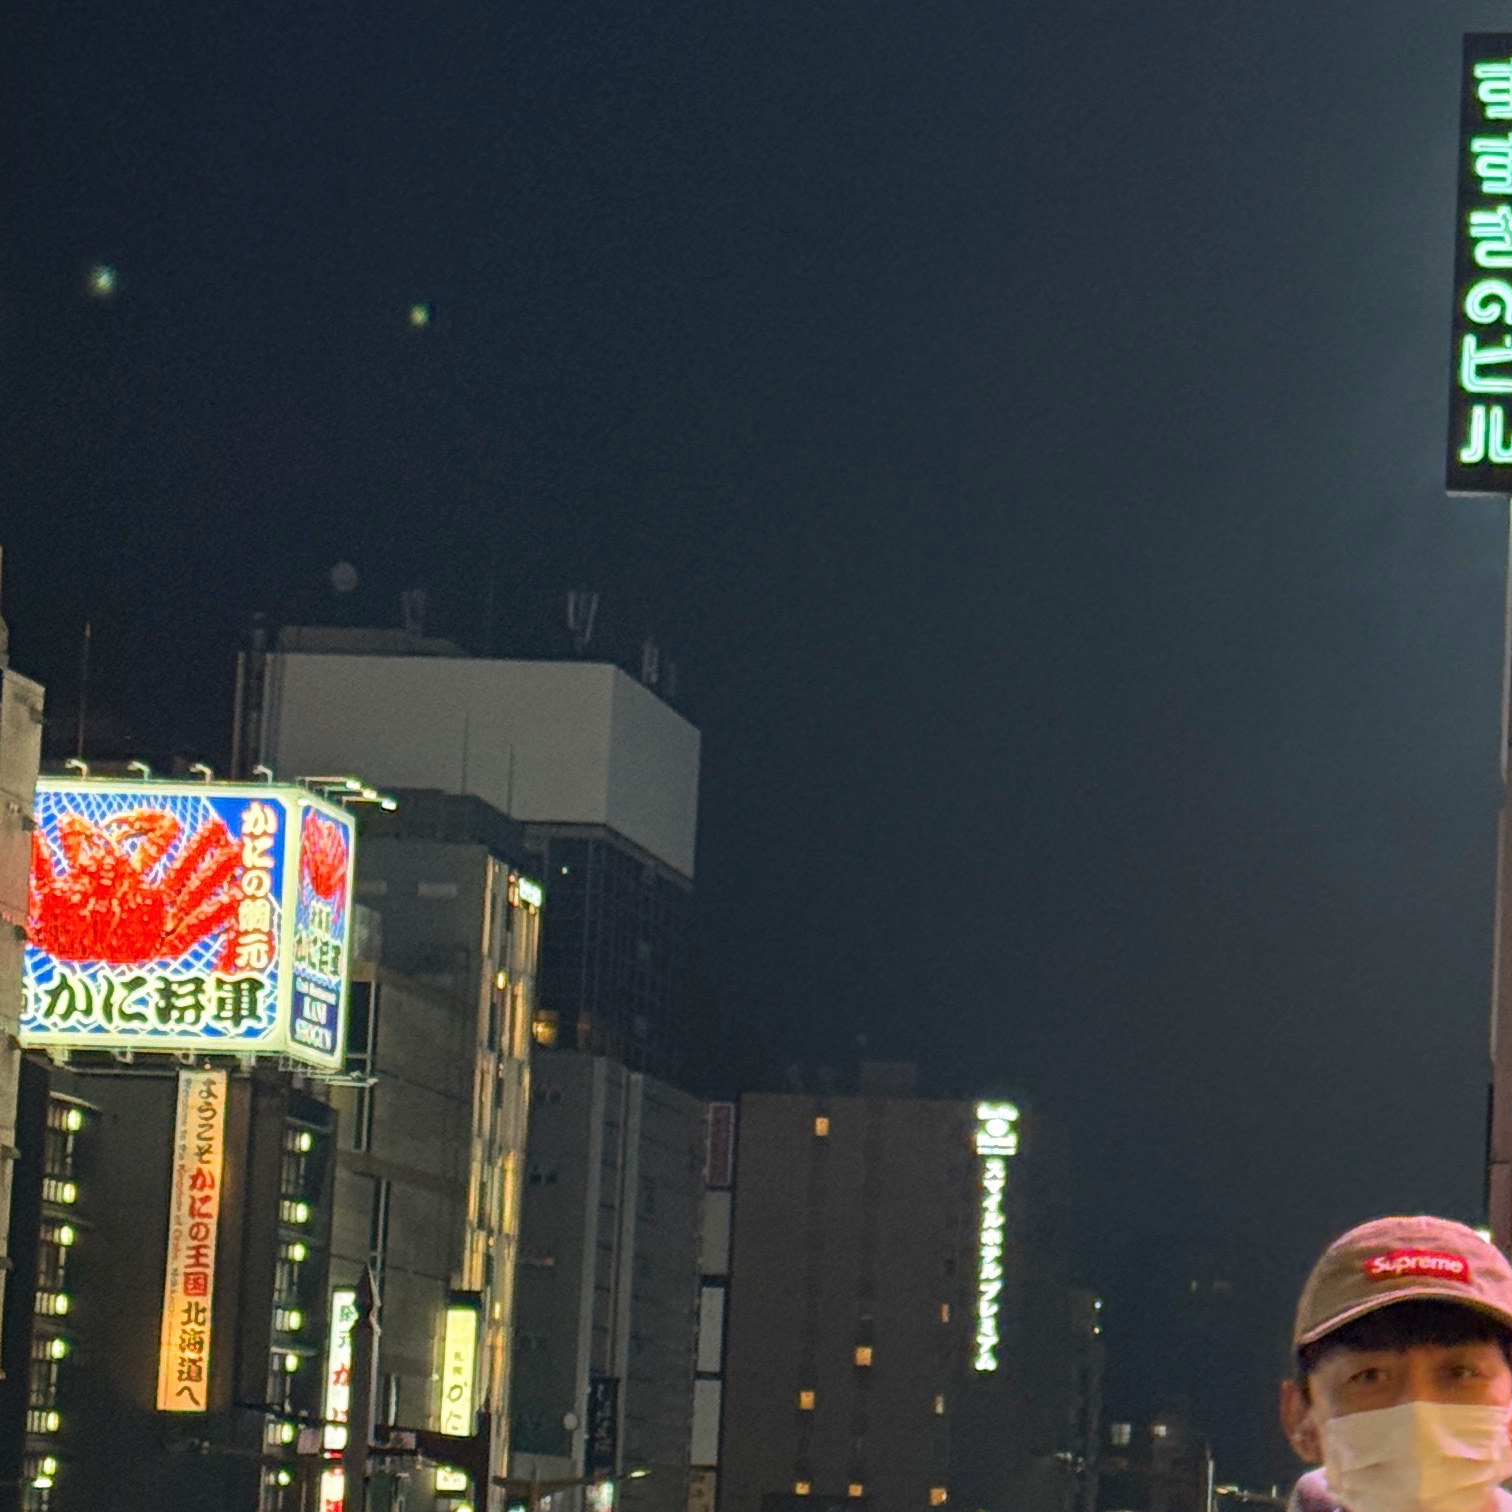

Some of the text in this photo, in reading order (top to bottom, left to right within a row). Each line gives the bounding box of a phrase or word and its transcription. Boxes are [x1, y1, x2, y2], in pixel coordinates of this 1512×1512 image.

[42, 971, 267, 1029] かに将軍
[1371, 1256, 1465, 1275] Supreme
